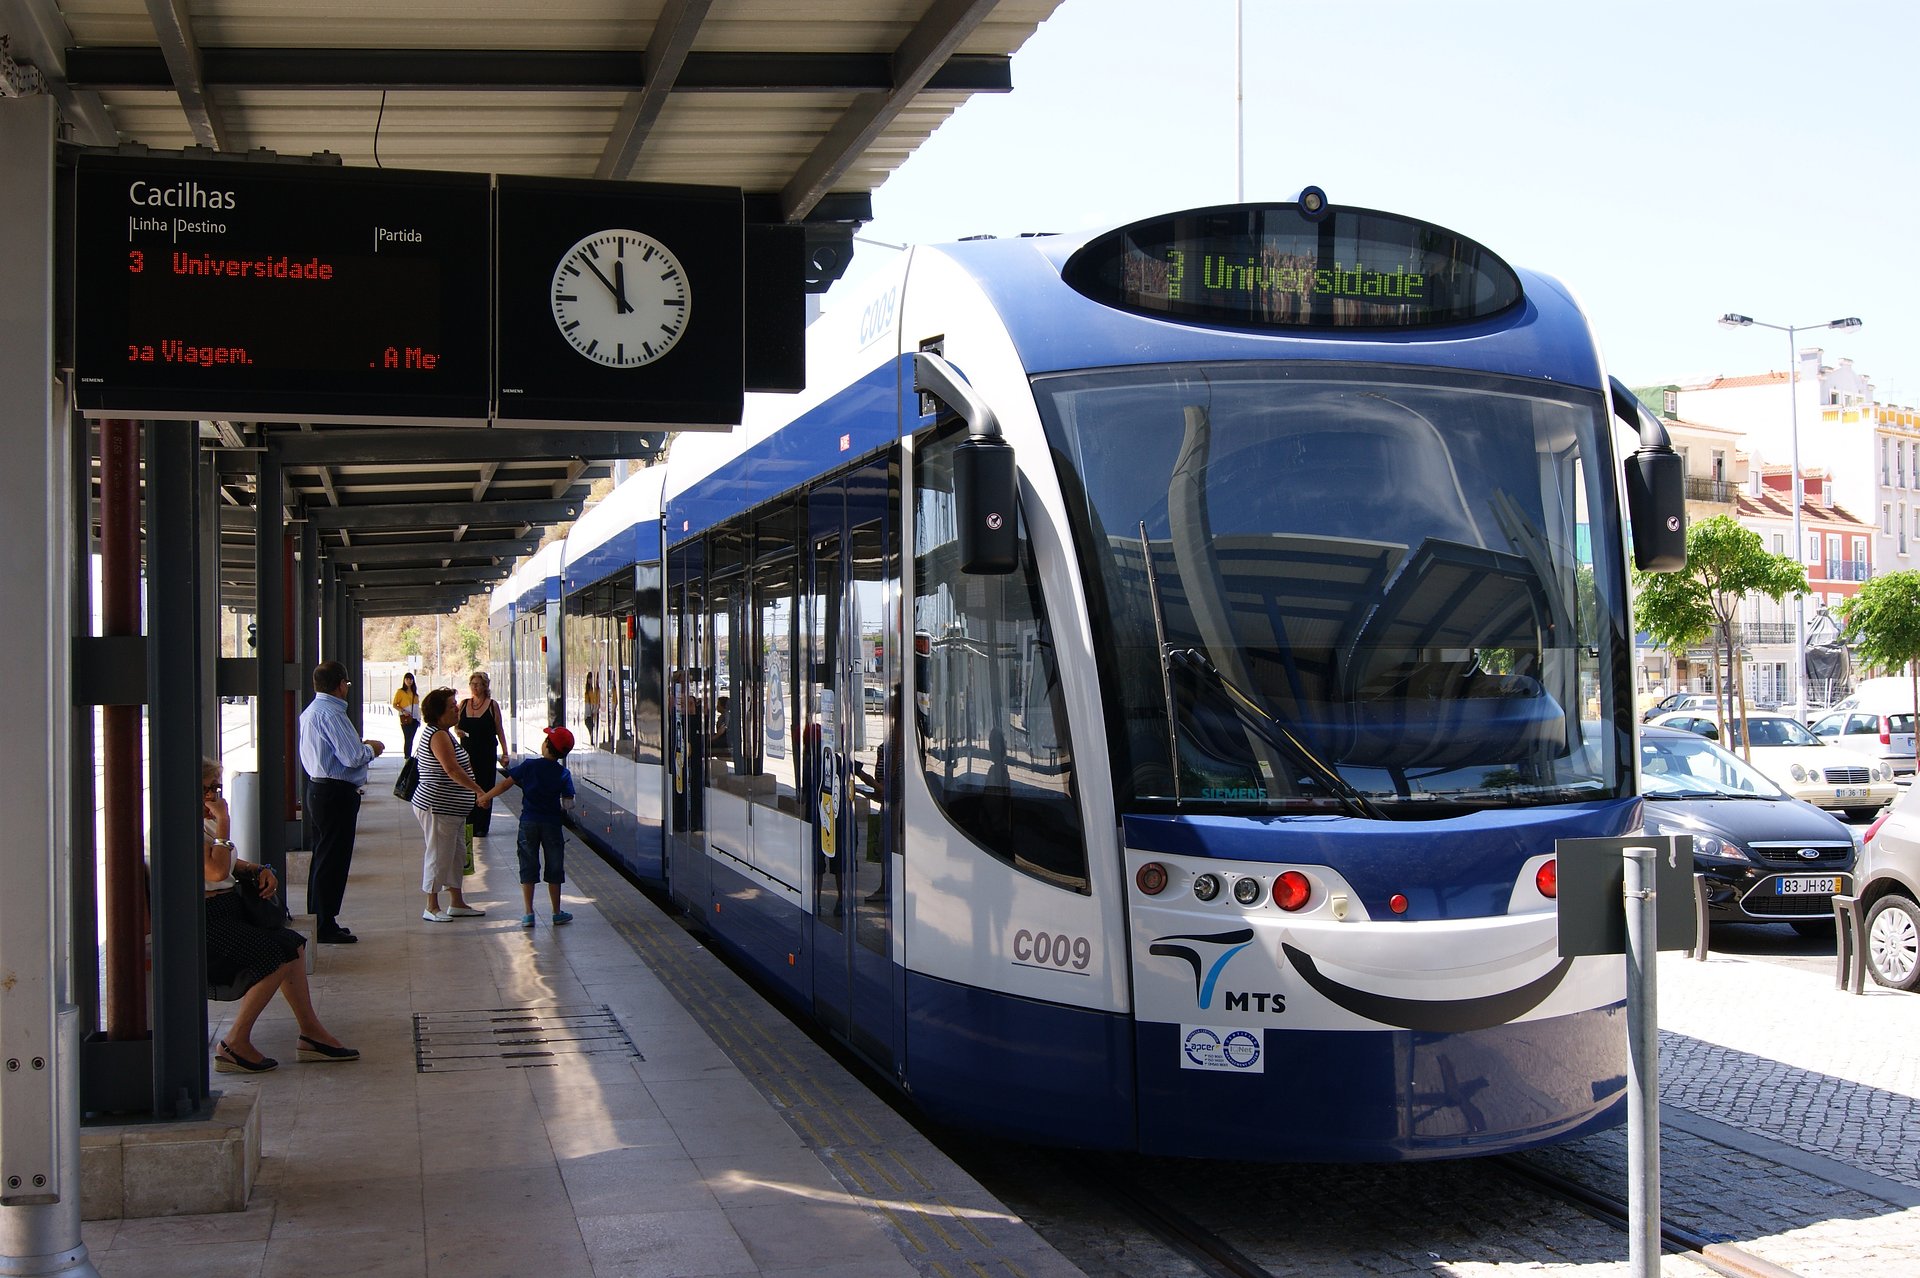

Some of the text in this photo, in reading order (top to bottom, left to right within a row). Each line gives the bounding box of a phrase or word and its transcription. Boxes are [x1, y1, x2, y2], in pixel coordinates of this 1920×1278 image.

[129, 181, 236, 209] Cacilhas
[132, 217, 168, 231] Linha
[178, 219, 227, 234] Destino
[379, 228, 423, 242] Partida
[129, 250, 333, 280] 3 Universidade
[1166, 250, 1424, 298] 3 Universidade
[162, 339, 253, 367] Viagem.
[384, 346, 398, 368] A
[1201, 788, 1267, 799] SIEMENS
[1013, 929, 1091, 970] C009
[1225, 991, 1287, 1014] MTS
[1191, 1043, 1215, 1052] apcer
